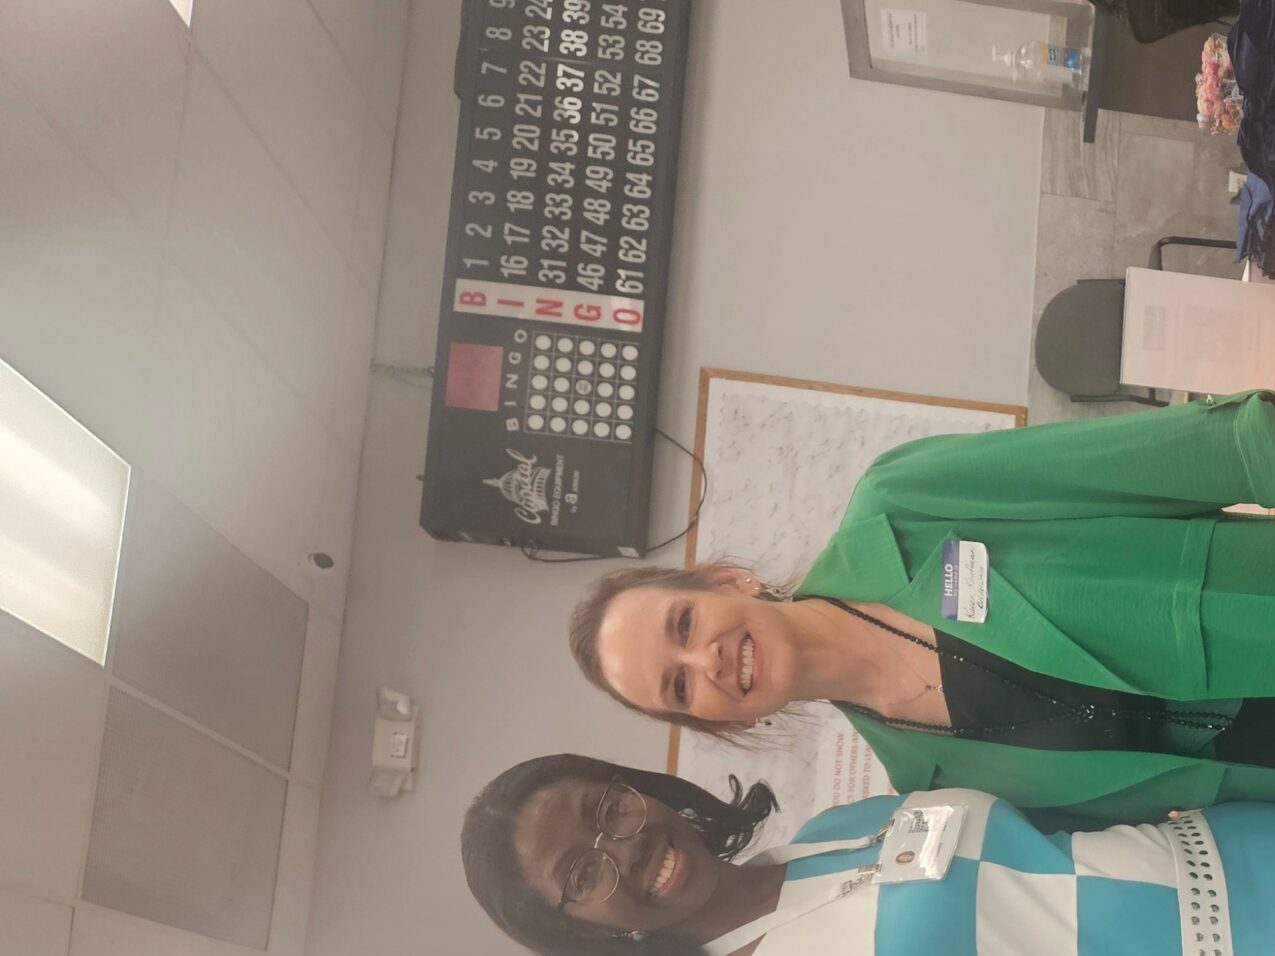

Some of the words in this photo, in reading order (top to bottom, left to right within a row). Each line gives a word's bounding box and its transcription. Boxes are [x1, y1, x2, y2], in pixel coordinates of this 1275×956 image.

[562, 0, 590, 24] 39
[600, 4, 628, 29] 54
[638, 8, 665, 34] 69
[485, 27, 512, 40] 8
[522, 26, 550, 52] 23
[560, 30, 588, 56] 38
[598, 34, 625, 60] 53
[635, 40, 663, 65] 68
[482, 62, 507, 74] 7
[519, 61, 546, 87] 22
[556, 64, 584, 91] 37
[594, 70, 621, 96] 52
[632, 75, 660, 101] 67
[478, 95, 505, 108] 6
[515, 94, 543, 117] 21
[553, 96, 582, 123] 36
[591, 102, 618, 126] 51
[476, 127, 501, 140] 5
[630, 108, 657, 134] 66
[513, 124, 540, 151] 20
[551, 129, 578, 155] 35
[588, 133, 616, 160] 50
[627, 139, 655, 166] 65
[473, 160, 498, 172] 4
[510, 158, 537, 179] 19
[547, 162, 575, 187] 34
[586, 166, 613, 193] 49
[624, 172, 652, 198] 64
[469, 191, 495, 204] 3
[507, 191, 534, 212] 18
[545, 194, 573, 220] 33
[583, 199, 611, 225] 48
[621, 204, 649, 231] 63
[466, 224, 492, 237] 2
[504, 223, 530, 245] 17
[541, 225, 570, 252] 32
[580, 231, 608, 257] 47
[619, 236, 647, 263] 62
[463, 258, 489, 267] 1
[500, 256, 528, 278] 16
[539, 259, 566, 283] 31
[577, 263, 605, 291] 46
[616, 269, 644, 293] 61
[504, 330, 527, 431] BINGO
[506, 448, 542, 524] Capital
[553, 454, 564, 498] EQUIPMENT
[551, 500, 561, 525] BINGO
[944, 564, 953, 596] HELLO
[834, 760, 842, 776] NOT
[849, 745, 858, 772] OTHERS
[864, 763, 871, 772] TO
[833, 777, 840, 790] DO
